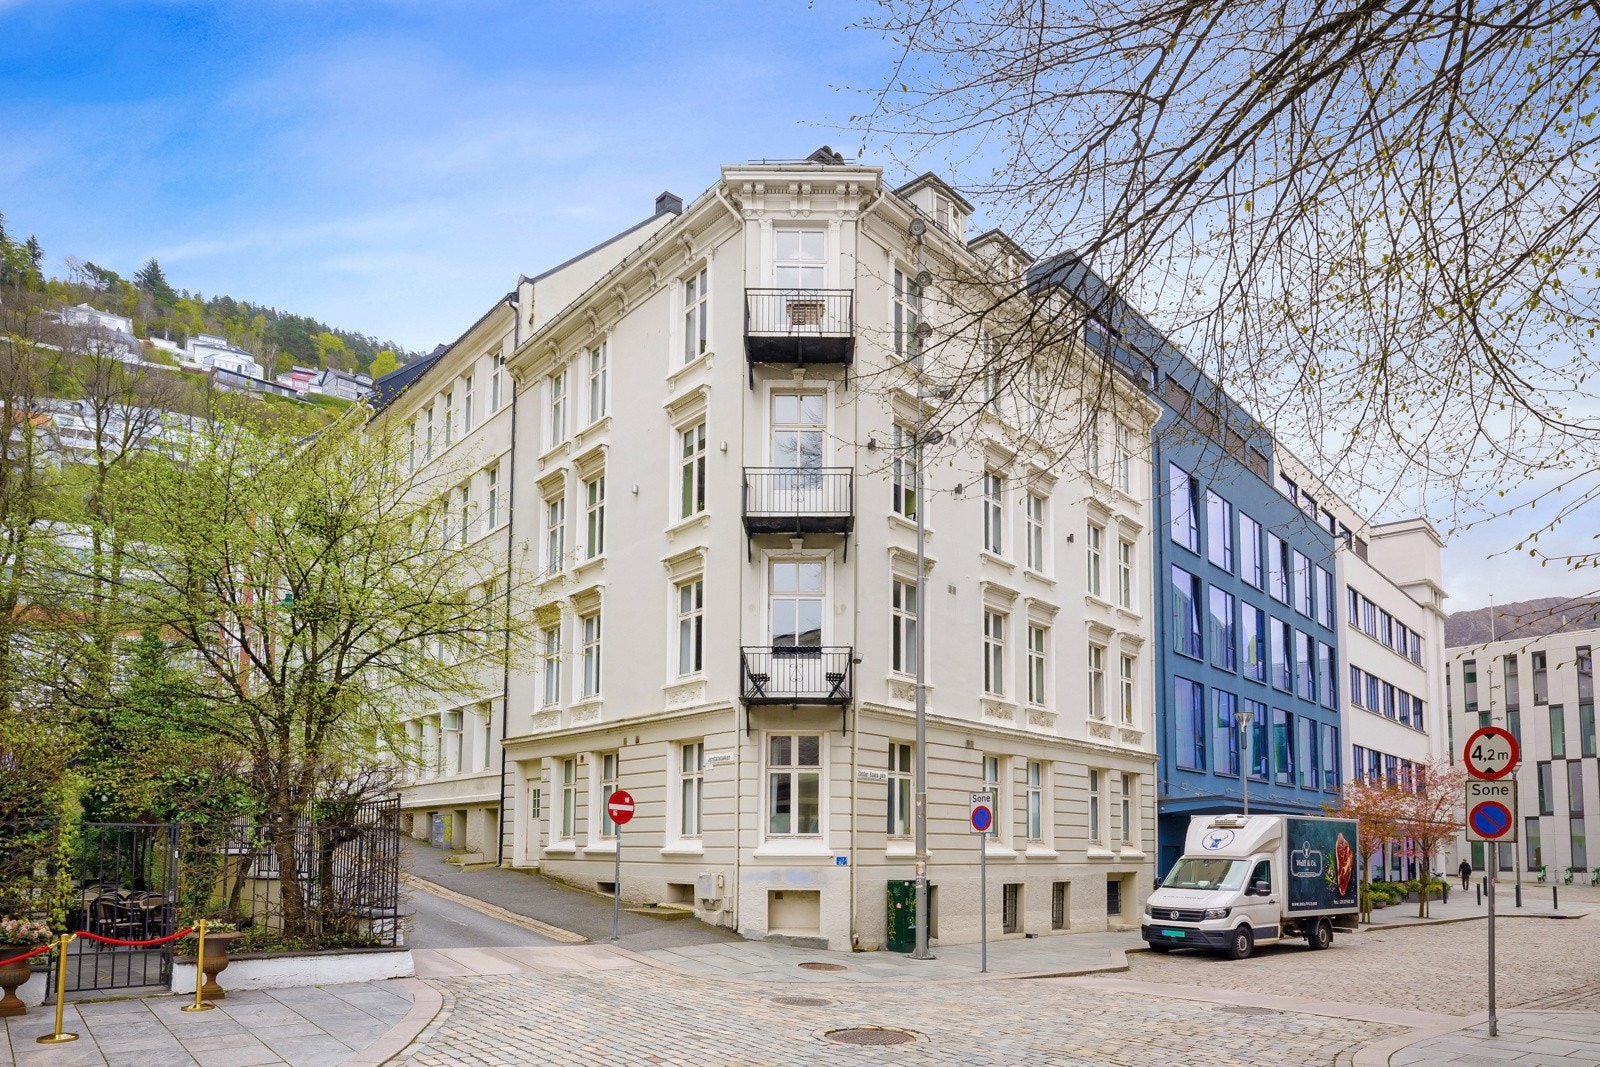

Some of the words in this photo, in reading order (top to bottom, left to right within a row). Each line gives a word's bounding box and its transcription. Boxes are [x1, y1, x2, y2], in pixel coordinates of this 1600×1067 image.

[1472, 745, 1495, 762] 4,2
[1498, 751, 1509, 760] m
[1472, 784, 1509, 796] Sone
[972, 795, 991, 803] Sone
